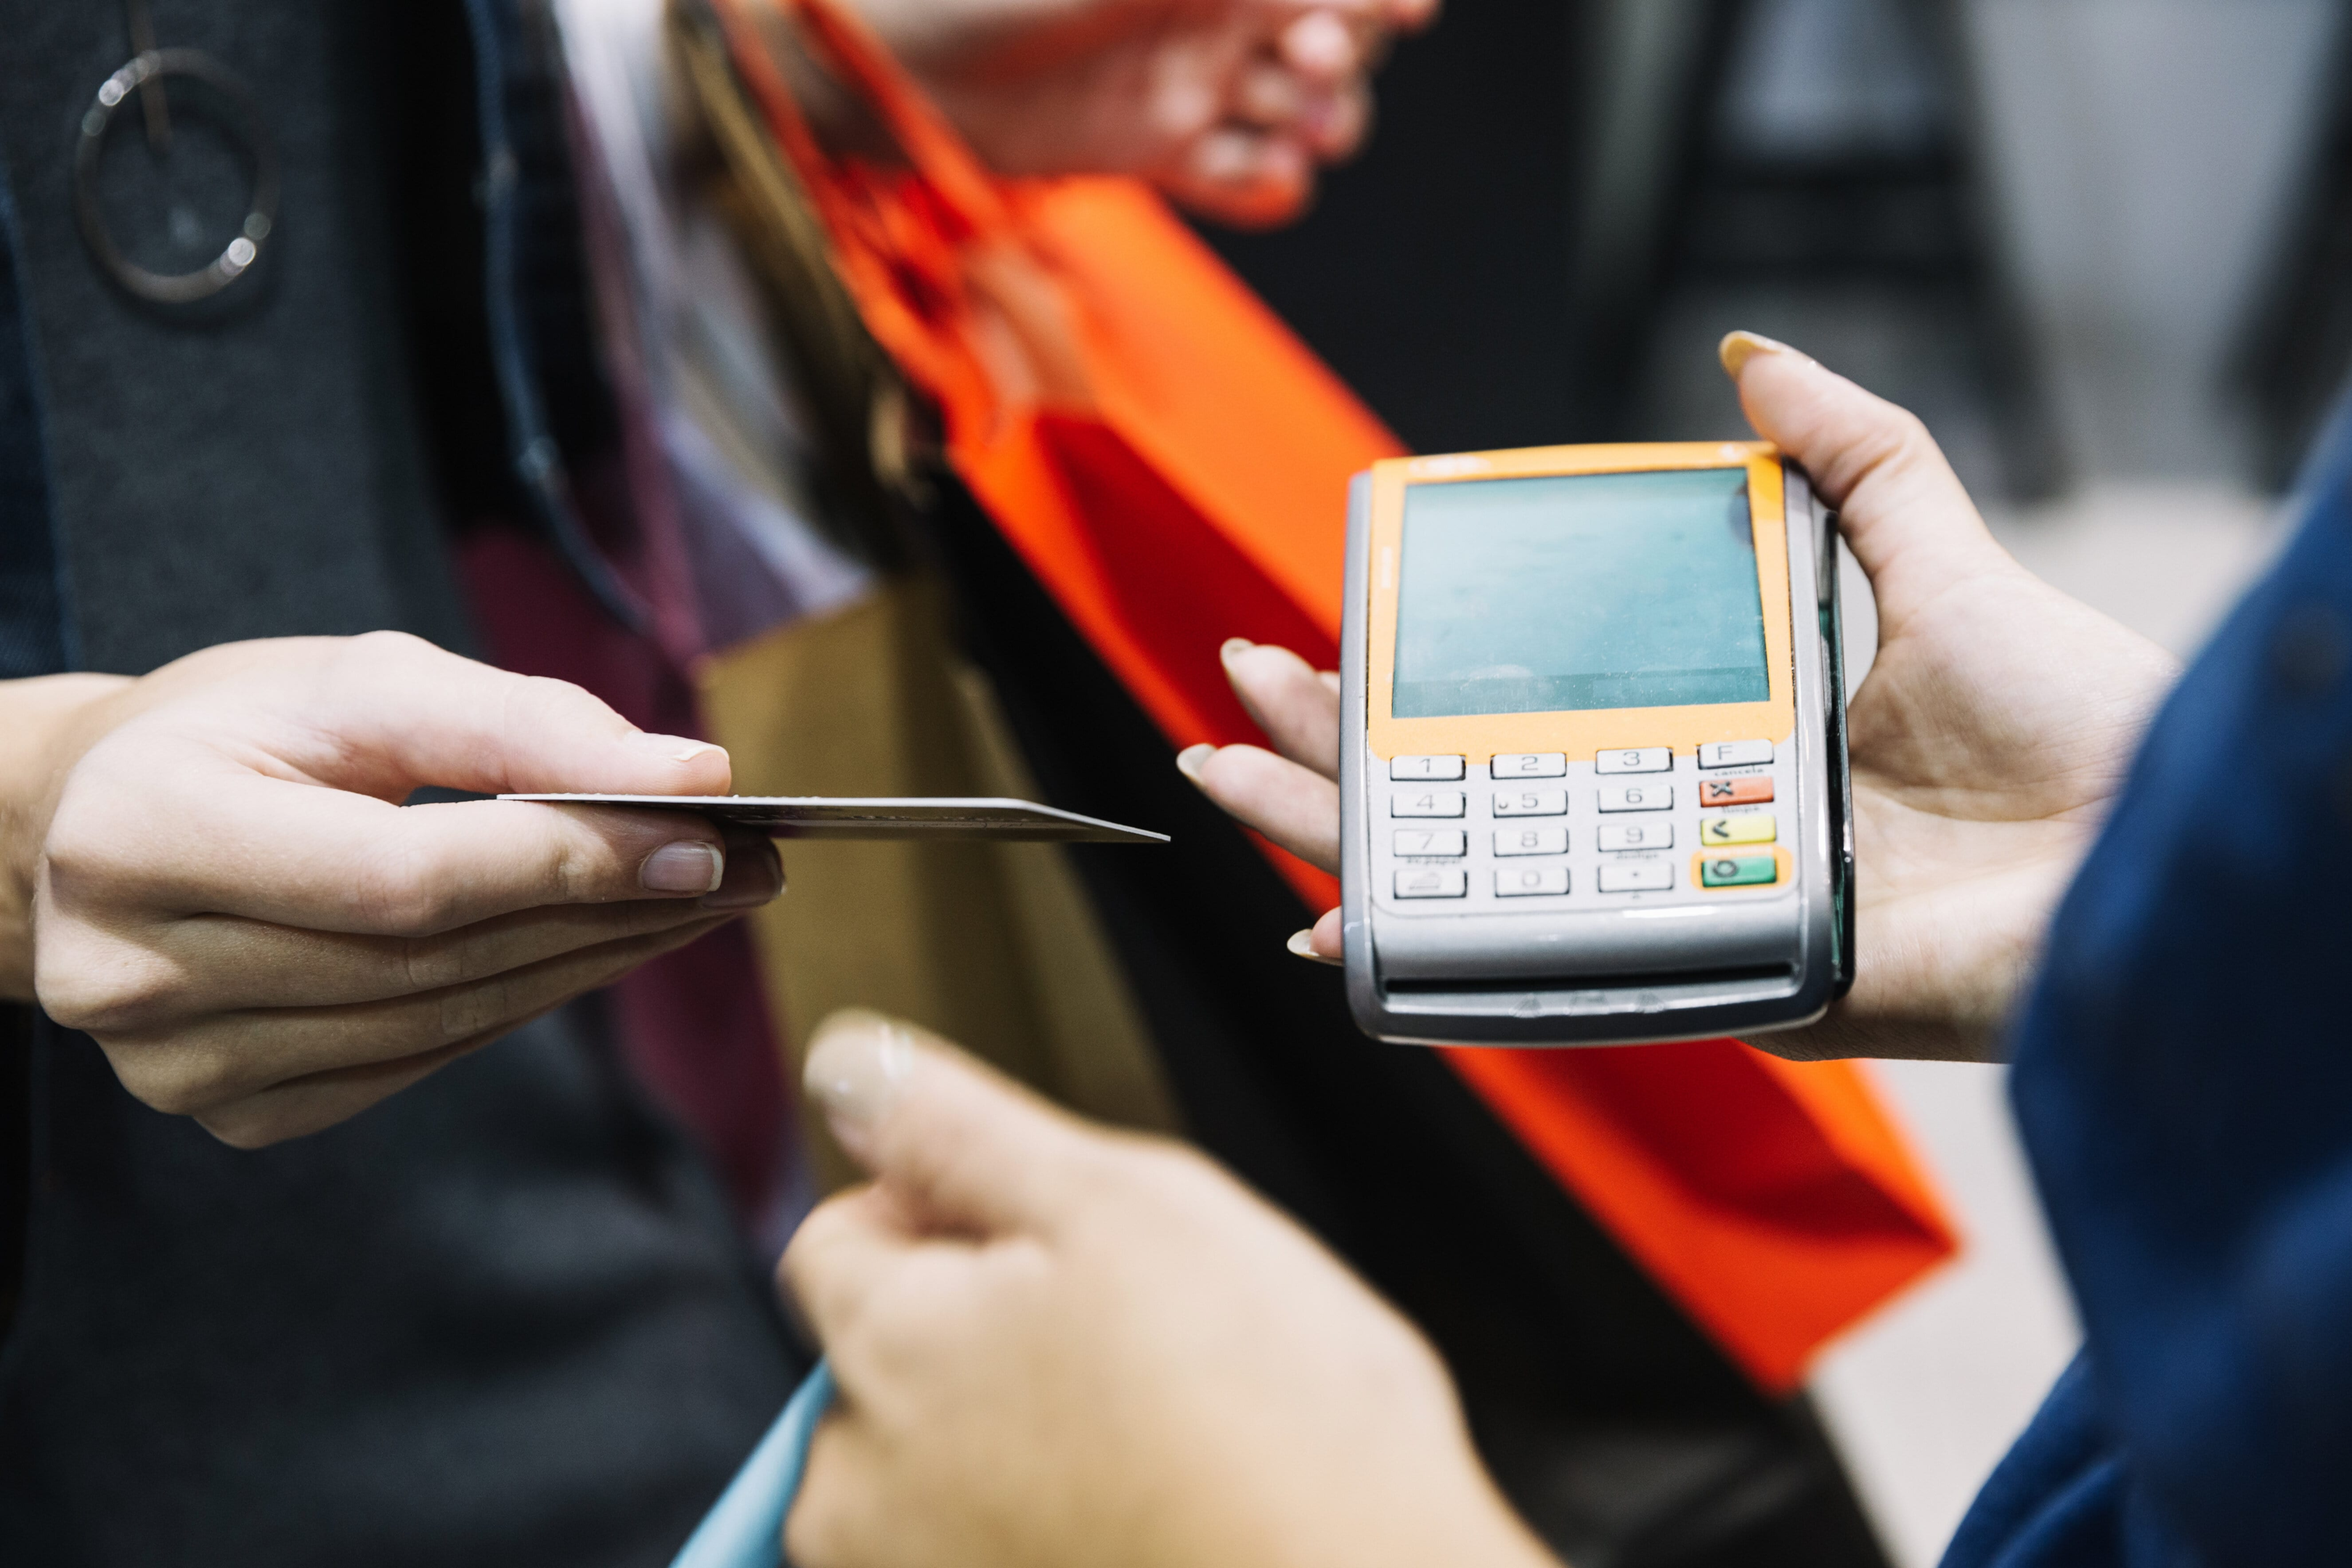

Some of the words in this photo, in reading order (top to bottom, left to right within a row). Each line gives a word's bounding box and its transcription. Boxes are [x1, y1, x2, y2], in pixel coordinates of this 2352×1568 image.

[1623, 751, 1640, 767] 3
[1717, 745, 1733, 760] F
[1419, 758, 1431, 773] 1
[1521, 756, 1538, 771] 2
[1416, 794, 1435, 809] 4
[1522, 793, 1538, 808] 5
[1626, 788, 1643, 803] 6
[1417, 833, 1435, 850] 7
[1521, 832, 1538, 847] 8
[1626, 827, 1643, 844] 9
